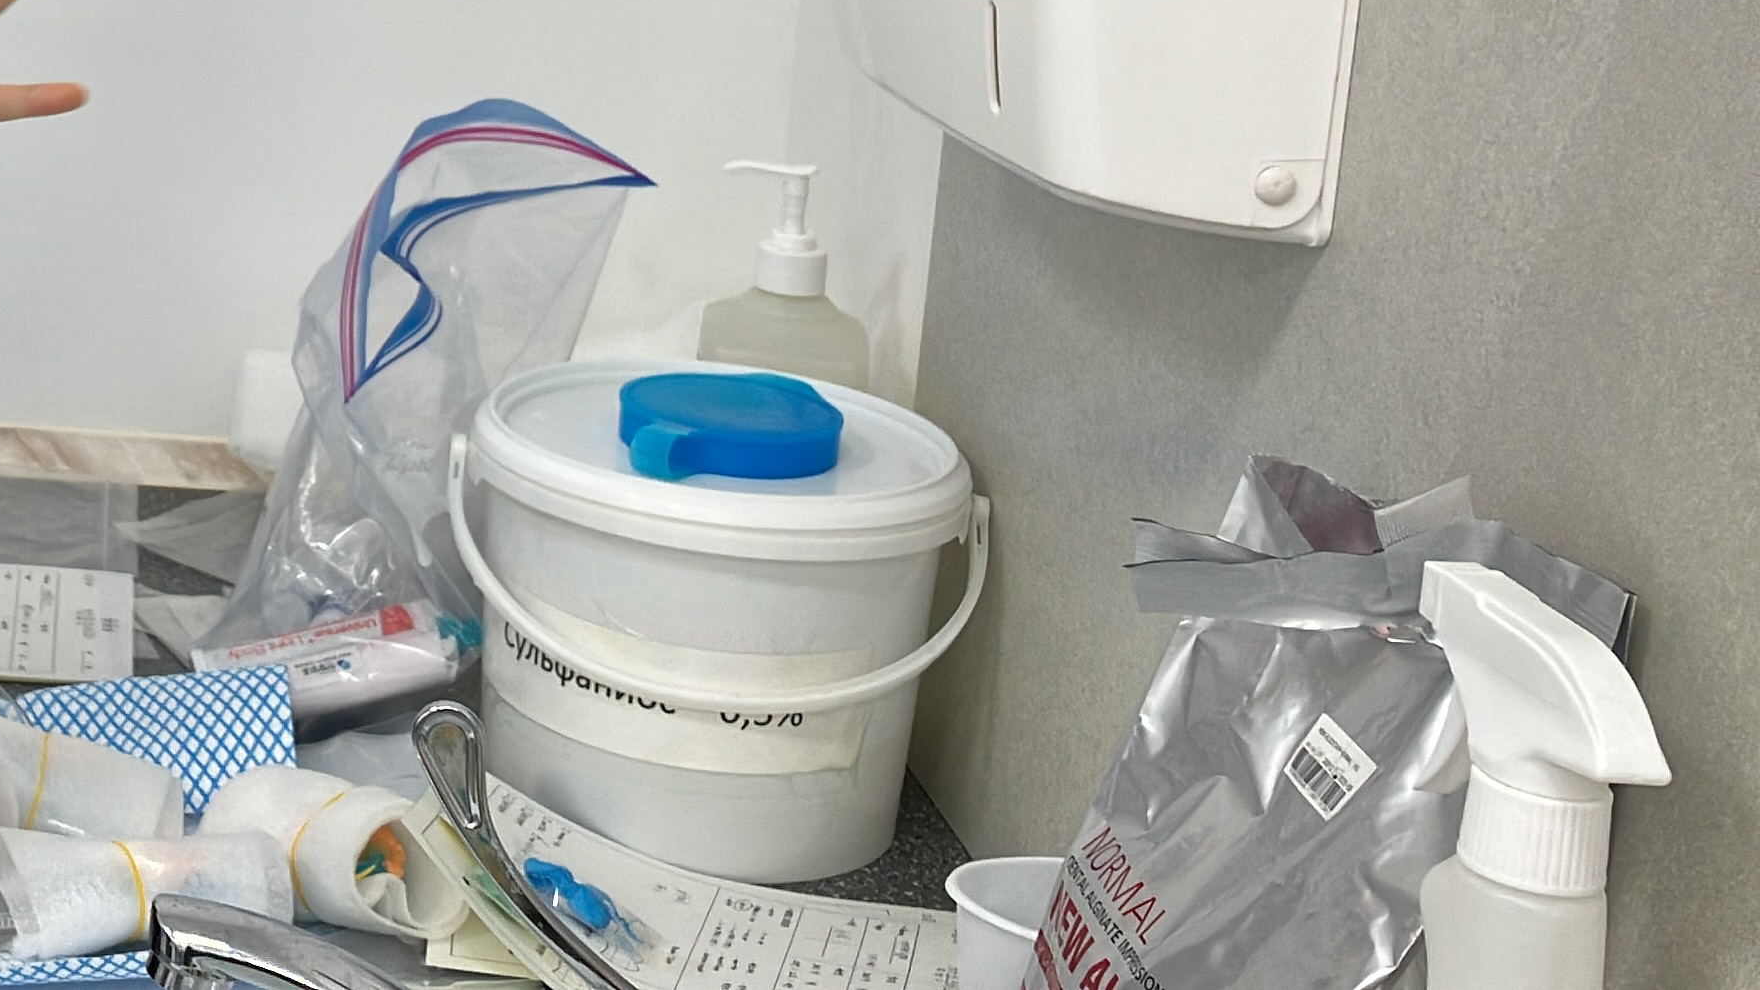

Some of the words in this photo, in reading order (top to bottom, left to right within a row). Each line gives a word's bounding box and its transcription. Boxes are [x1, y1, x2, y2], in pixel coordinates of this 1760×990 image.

[1049, 879, 1095, 974] NEW
[1065, 855, 1090, 896] DENTAL
[1085, 891, 1123, 945] ALGINATE
[1081, 826, 1166, 946] NORMAL
